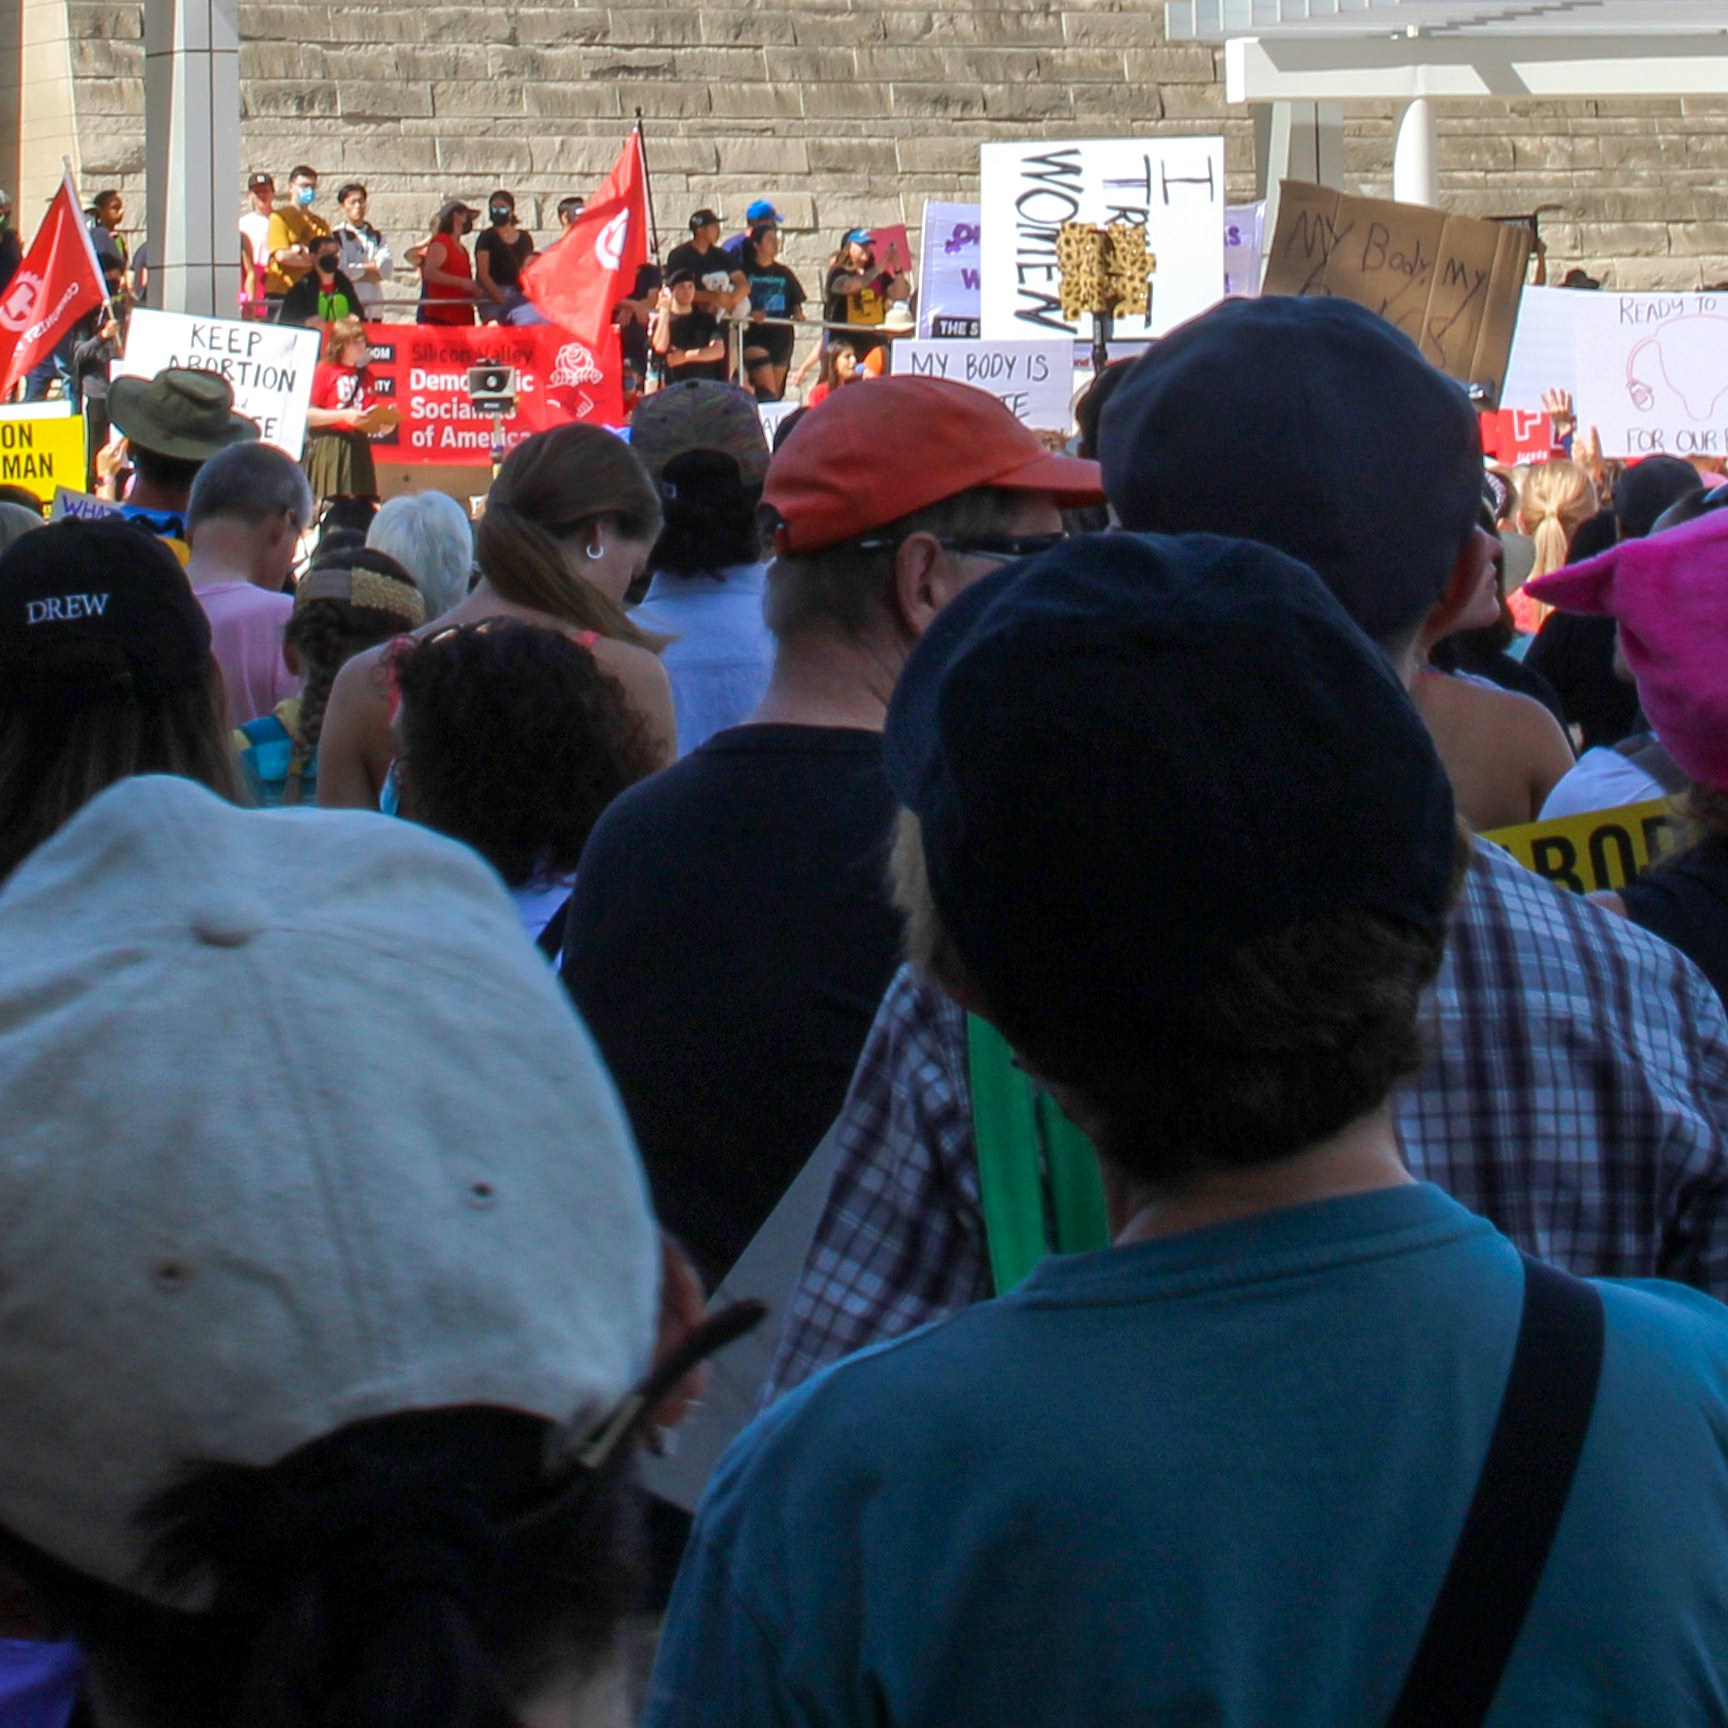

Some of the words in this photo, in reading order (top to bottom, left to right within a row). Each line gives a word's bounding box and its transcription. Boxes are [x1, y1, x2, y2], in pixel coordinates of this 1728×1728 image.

[1014, 148, 1084, 334] WOMEN
[1619, 297, 1685, 324] READY
[1697, 297, 1717, 313] TO
[190, 323, 262, 357] KEEP
[411, 344, 471, 363] Silicon
[410, 368, 534, 392] Demoic
[911, 352, 948, 377] MY
[966, 354, 1017, 381] BODY
[1027, 355, 1049, 381] IS
[412, 426, 432, 448] of
[1626, 427, 1666, 453] FOR
[1676, 428, 1717, 452] OUR
[25, 593, 110, 626] DREW
